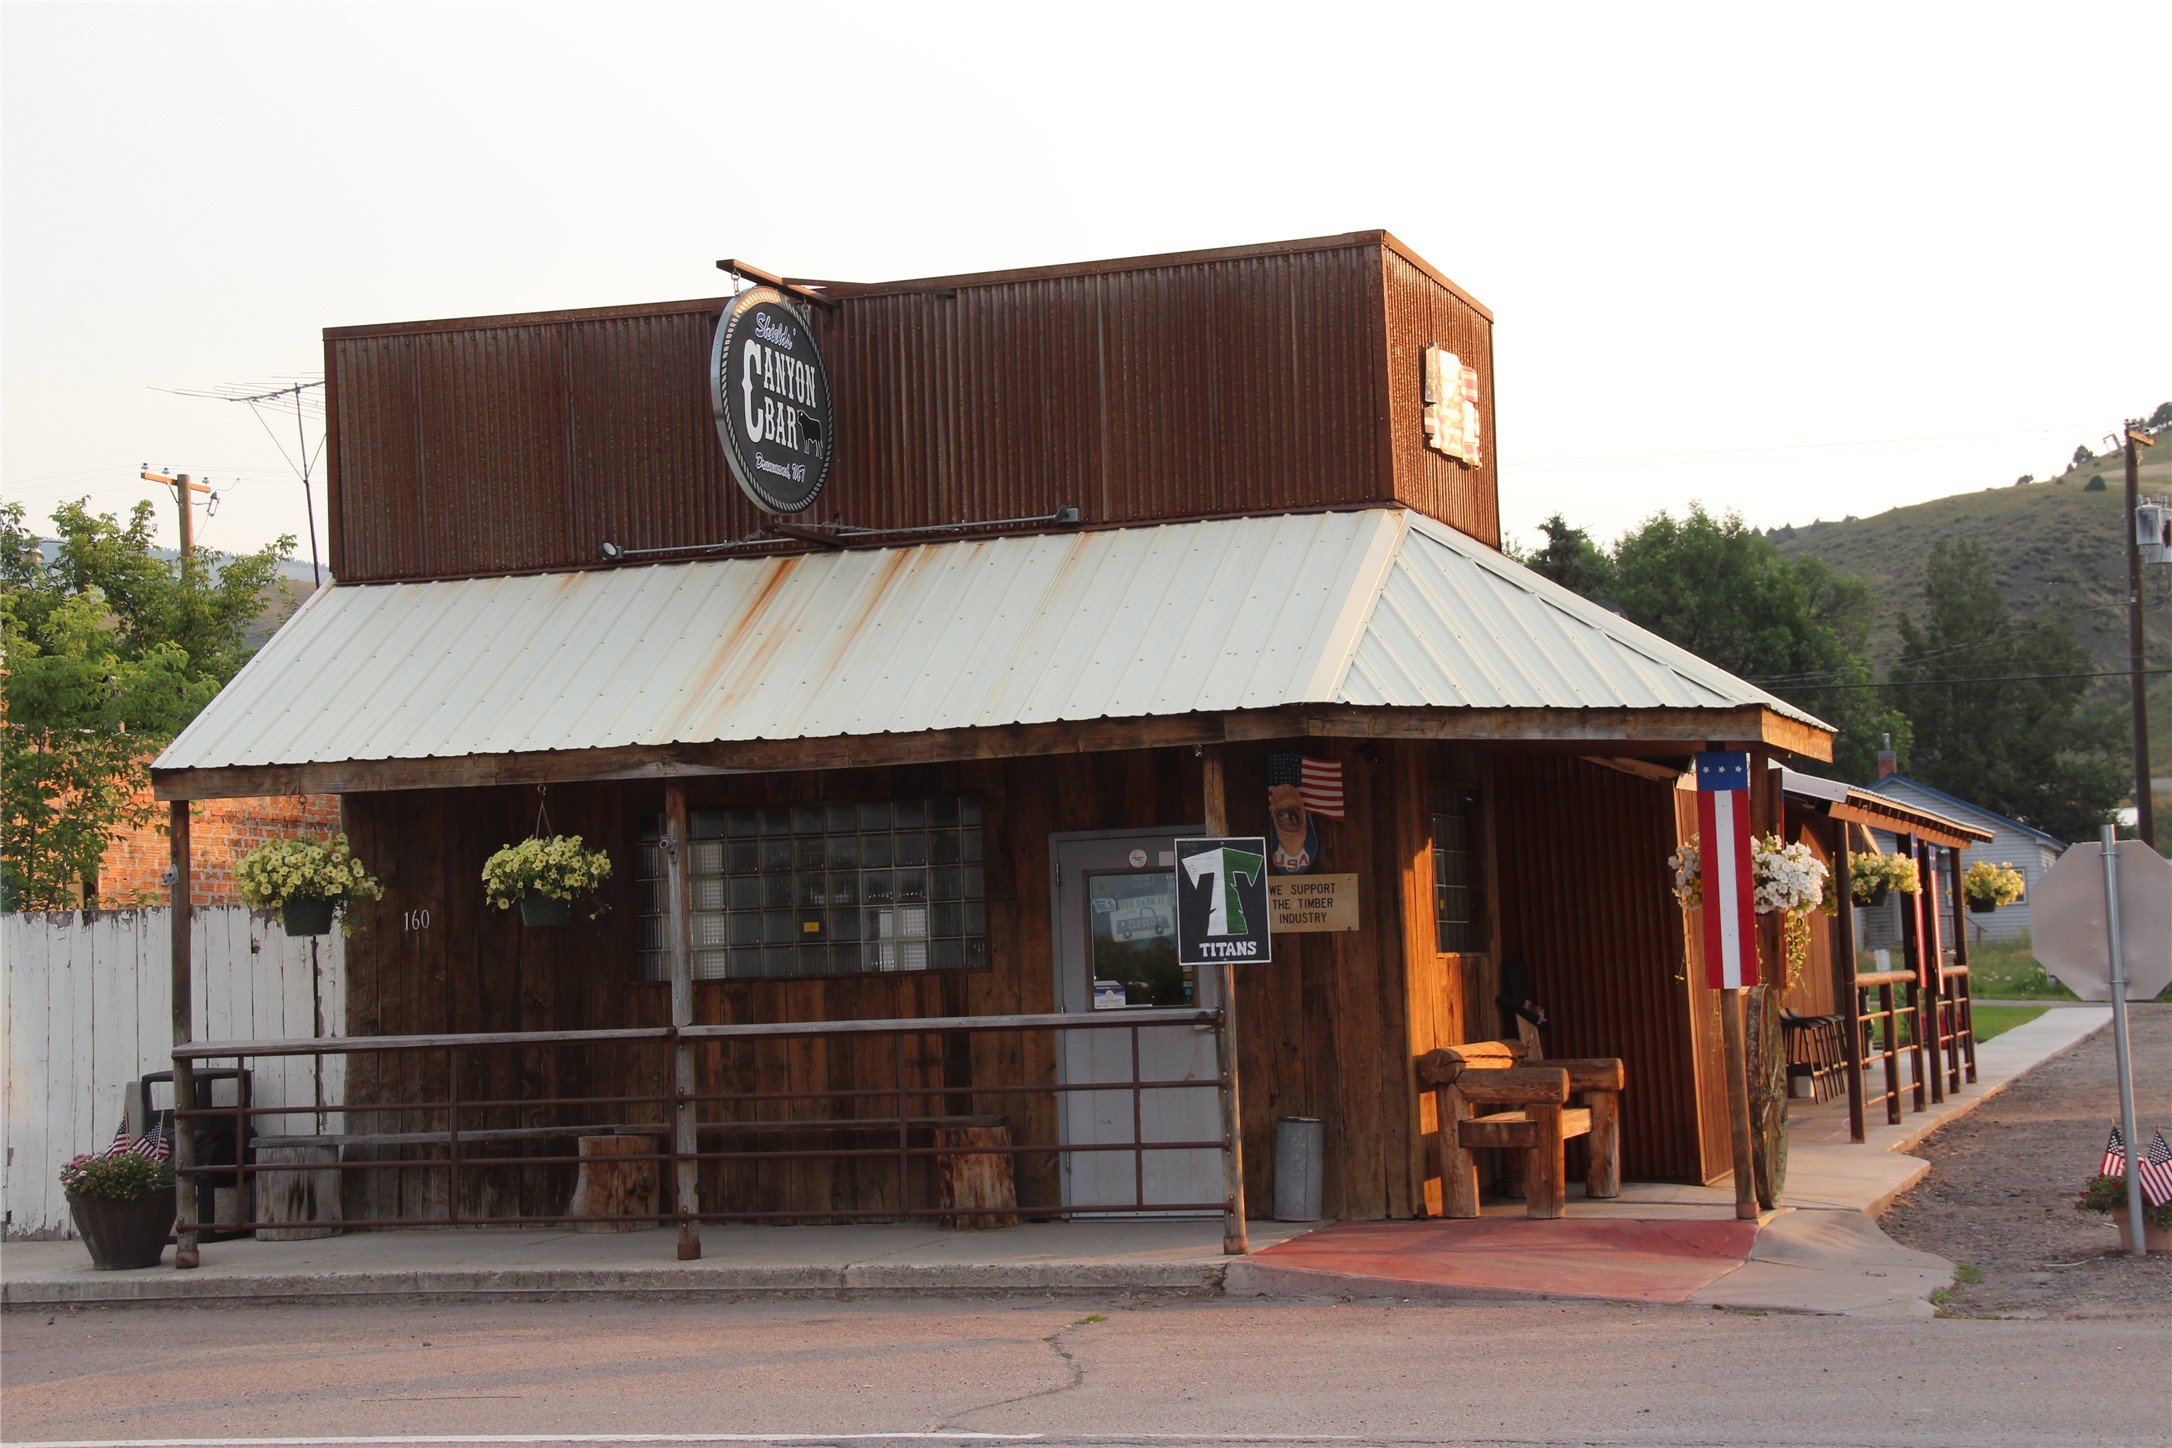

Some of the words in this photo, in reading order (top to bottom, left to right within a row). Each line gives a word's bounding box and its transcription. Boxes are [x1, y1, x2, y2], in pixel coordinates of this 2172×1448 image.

[742, 339, 816, 443] CANYON
[764, 396, 799, 451] BAR
[1274, 853, 1310, 871] USA
[1268, 885, 1283, 895] WE
[1291, 883, 1336, 895] SUPPORT
[1272, 899, 1291, 910] THE
[1298, 897, 1334, 909] TIMBER
[404, 909, 430, 931] 160
[1128, 917, 1157, 930] CLOSED
[1279, 912, 1327, 924] INDUSTRY
[1199, 941, 1257, 957] TITANS
